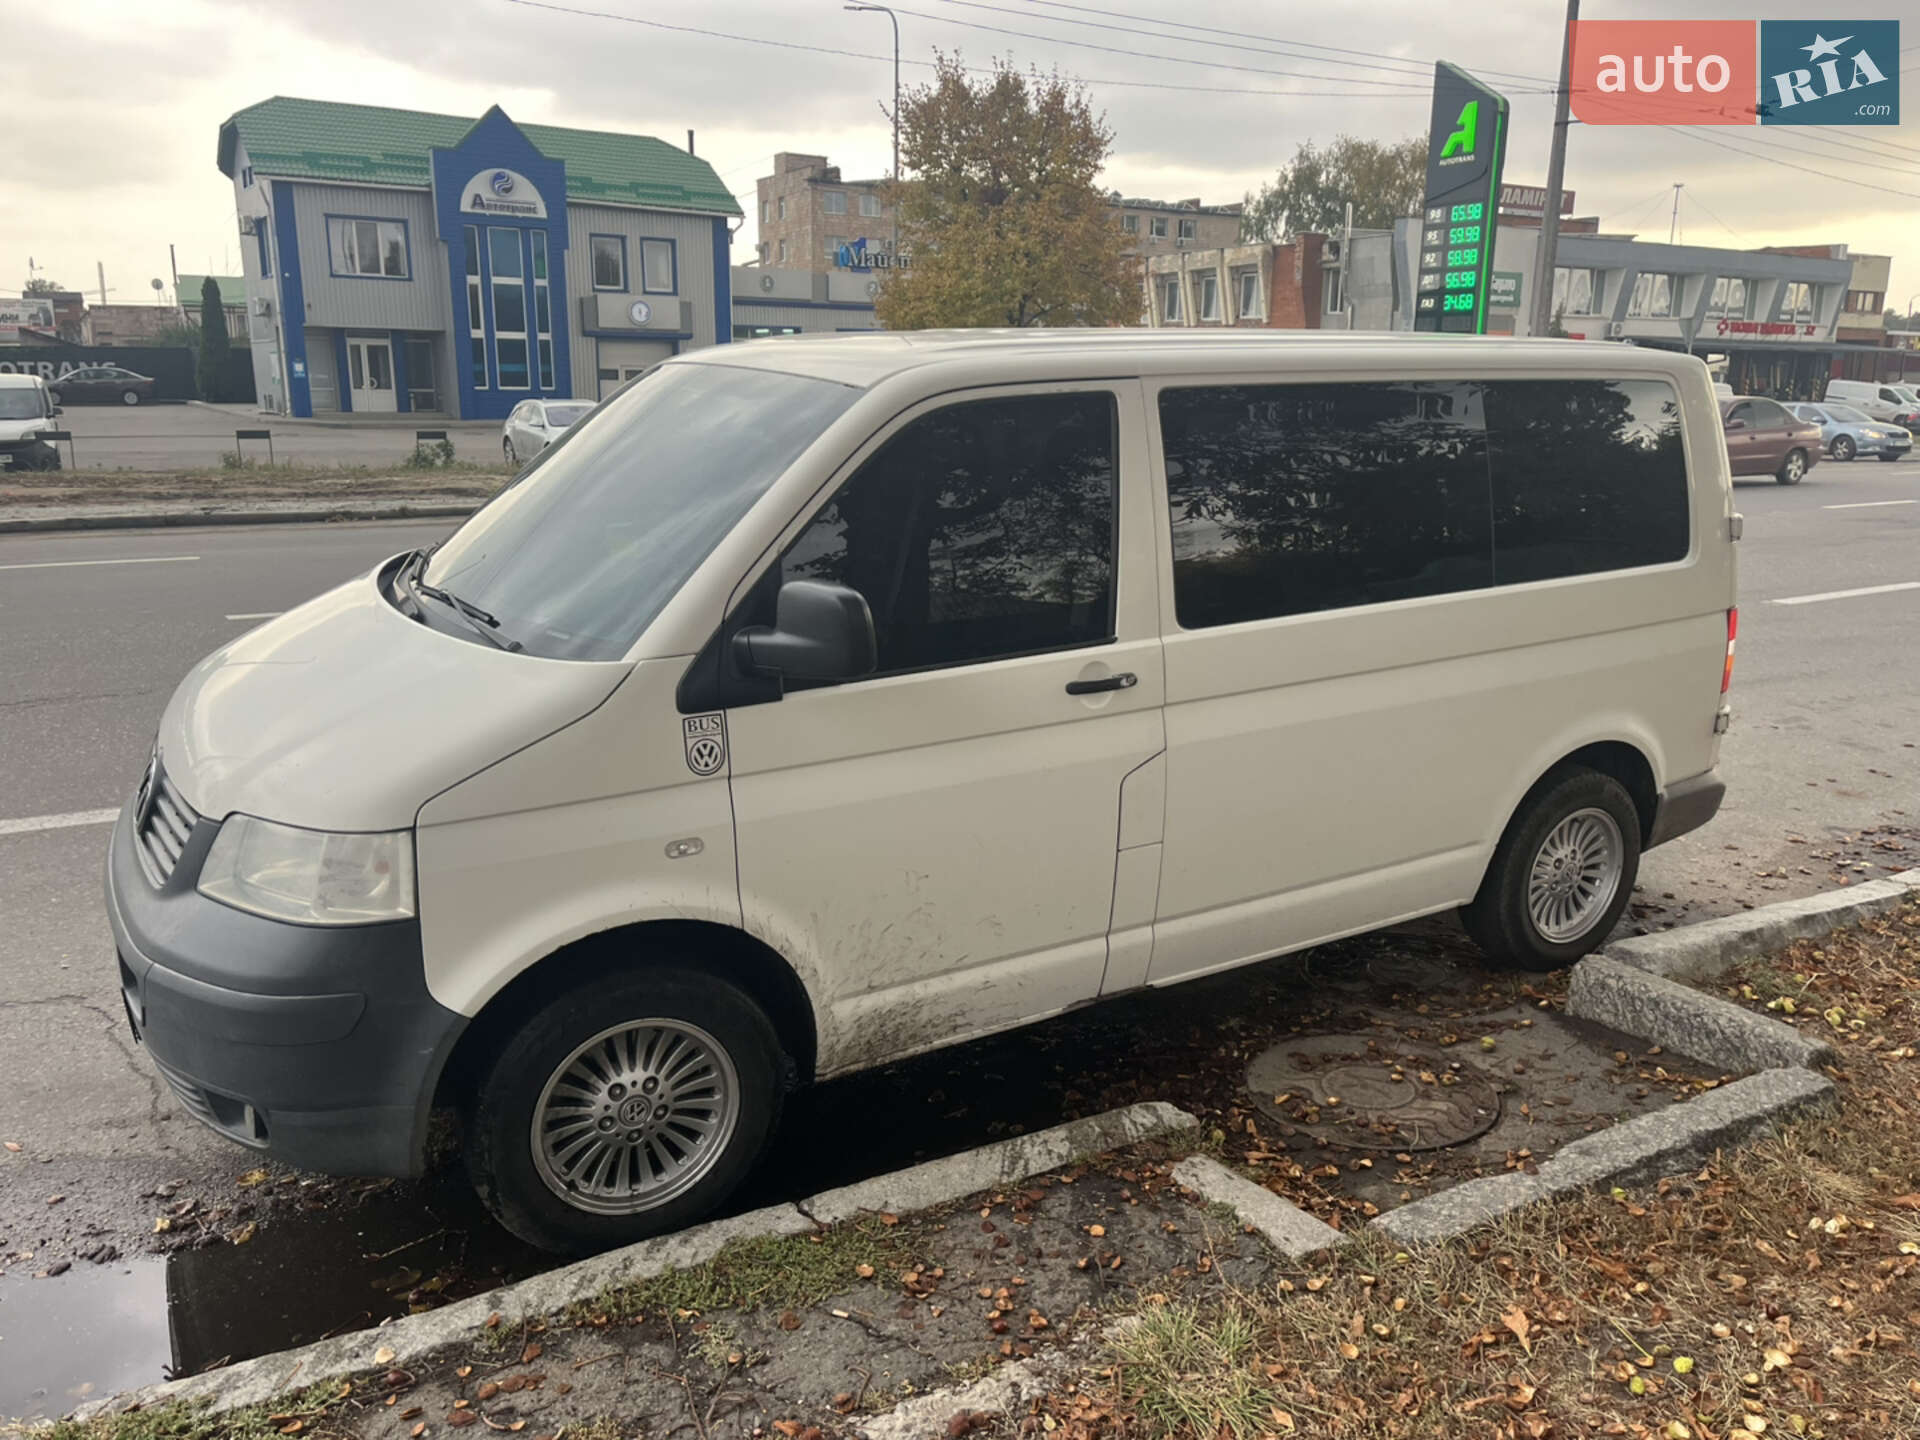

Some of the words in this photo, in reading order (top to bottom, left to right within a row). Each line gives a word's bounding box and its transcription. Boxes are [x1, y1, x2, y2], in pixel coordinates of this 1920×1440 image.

[1450, 203, 1483, 221] 65.98
[1427, 230, 1438, 241] 95
[1449, 226, 1480, 244] 59.98
[1425, 252, 1436, 263] 92
[1447, 248, 1478, 267] 58.98
[1445, 271, 1476, 289] 56.98
[1443, 293, 1475, 311] 34.68
[688, 716, 720, 732] BUS
